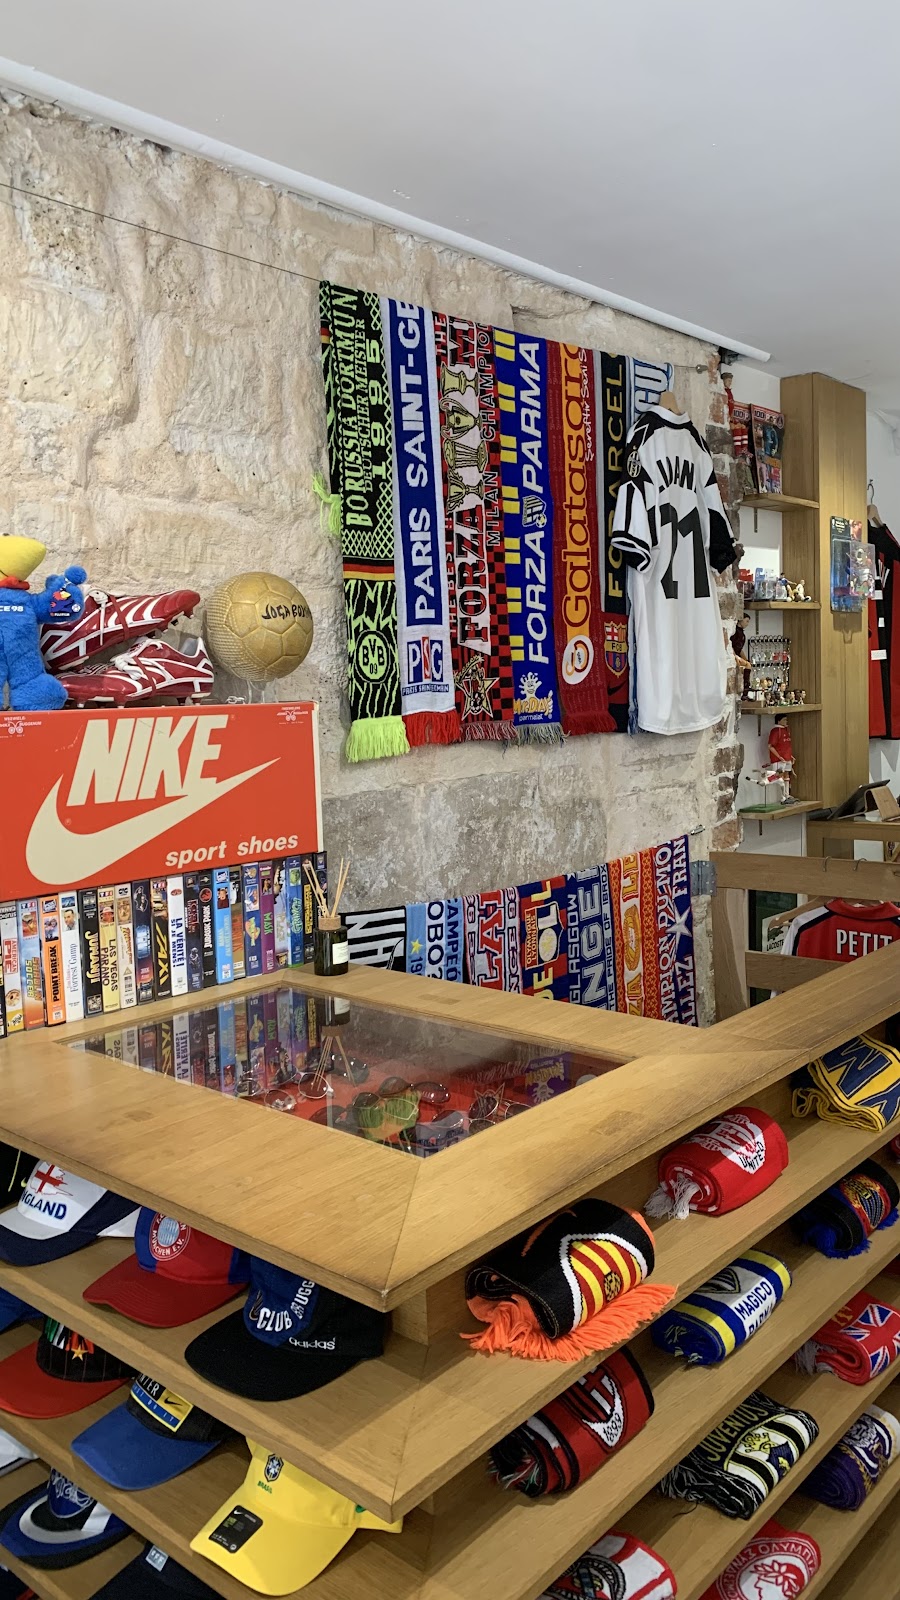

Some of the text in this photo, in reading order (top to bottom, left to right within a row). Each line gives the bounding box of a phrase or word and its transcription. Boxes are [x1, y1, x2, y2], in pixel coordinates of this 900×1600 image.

[435, 313, 448, 354] THE
[353, 319, 374, 493] DEUTSCHER MEISTER
[342, 416, 374, 527] BORUSSIA
[484, 472, 501, 547] MILAN
[518, 342, 550, 665] FORZA PARMA
[408, 507, 436, 620] PARIS
[445, 539, 456, 591] BEST
[659, 502, 711, 600] 21
[455, 504, 490, 644] FORZA
[362, 638, 385, 666] BVB
[369, 662, 378, 675] 09
[408, 637, 444, 684] PSG
[518, 713, 544, 722] parmalat
[66, 714, 229, 806] NIKE
[165, 834, 299, 869] sport shoes
[170, 918, 176, 927] SI
[175, 917, 184, 928] LA
[263, 911, 273, 936] MASK
[602, 912, 612, 931] OF
[656, 895, 669, 930] DU
[171, 930, 176, 938] JE
[524, 912, 532, 965] OLYMPIQUE
[530, 914, 538, 961] LYONNAIS
[537, 903, 559, 962] OL
[565, 893, 581, 1004] GLASGOW
[836, 928, 893, 957] PETIT
[4, 940, 13, 974] PIE
[11, 940, 19, 973] AMERICAN
[49, 944, 61, 1002] POINT BREAK
[68, 943, 79, 993] Forrest Gump
[85, 930, 100, 984] JUMANJI
[101, 947, 110, 986] PARANO
[109, 939, 119, 992] LAS VEGAS
[155, 922, 169, 986] TAXI
[410, 959, 424, 974] 19
[603, 938, 614, 977] PRIDE
[25, 960, 35, 998] SOCCER
[32, 957, 43, 1001] SHAOLIN
[605, 983, 616, 1011] THE
[739, 1140, 765, 1169] UNITED
[256, 1306, 293, 1333] CLUB
[734, 1280, 773, 1320] MAGICO
[289, 1336, 336, 1351] adidas
[602, 1412, 622, 1443] 1899
